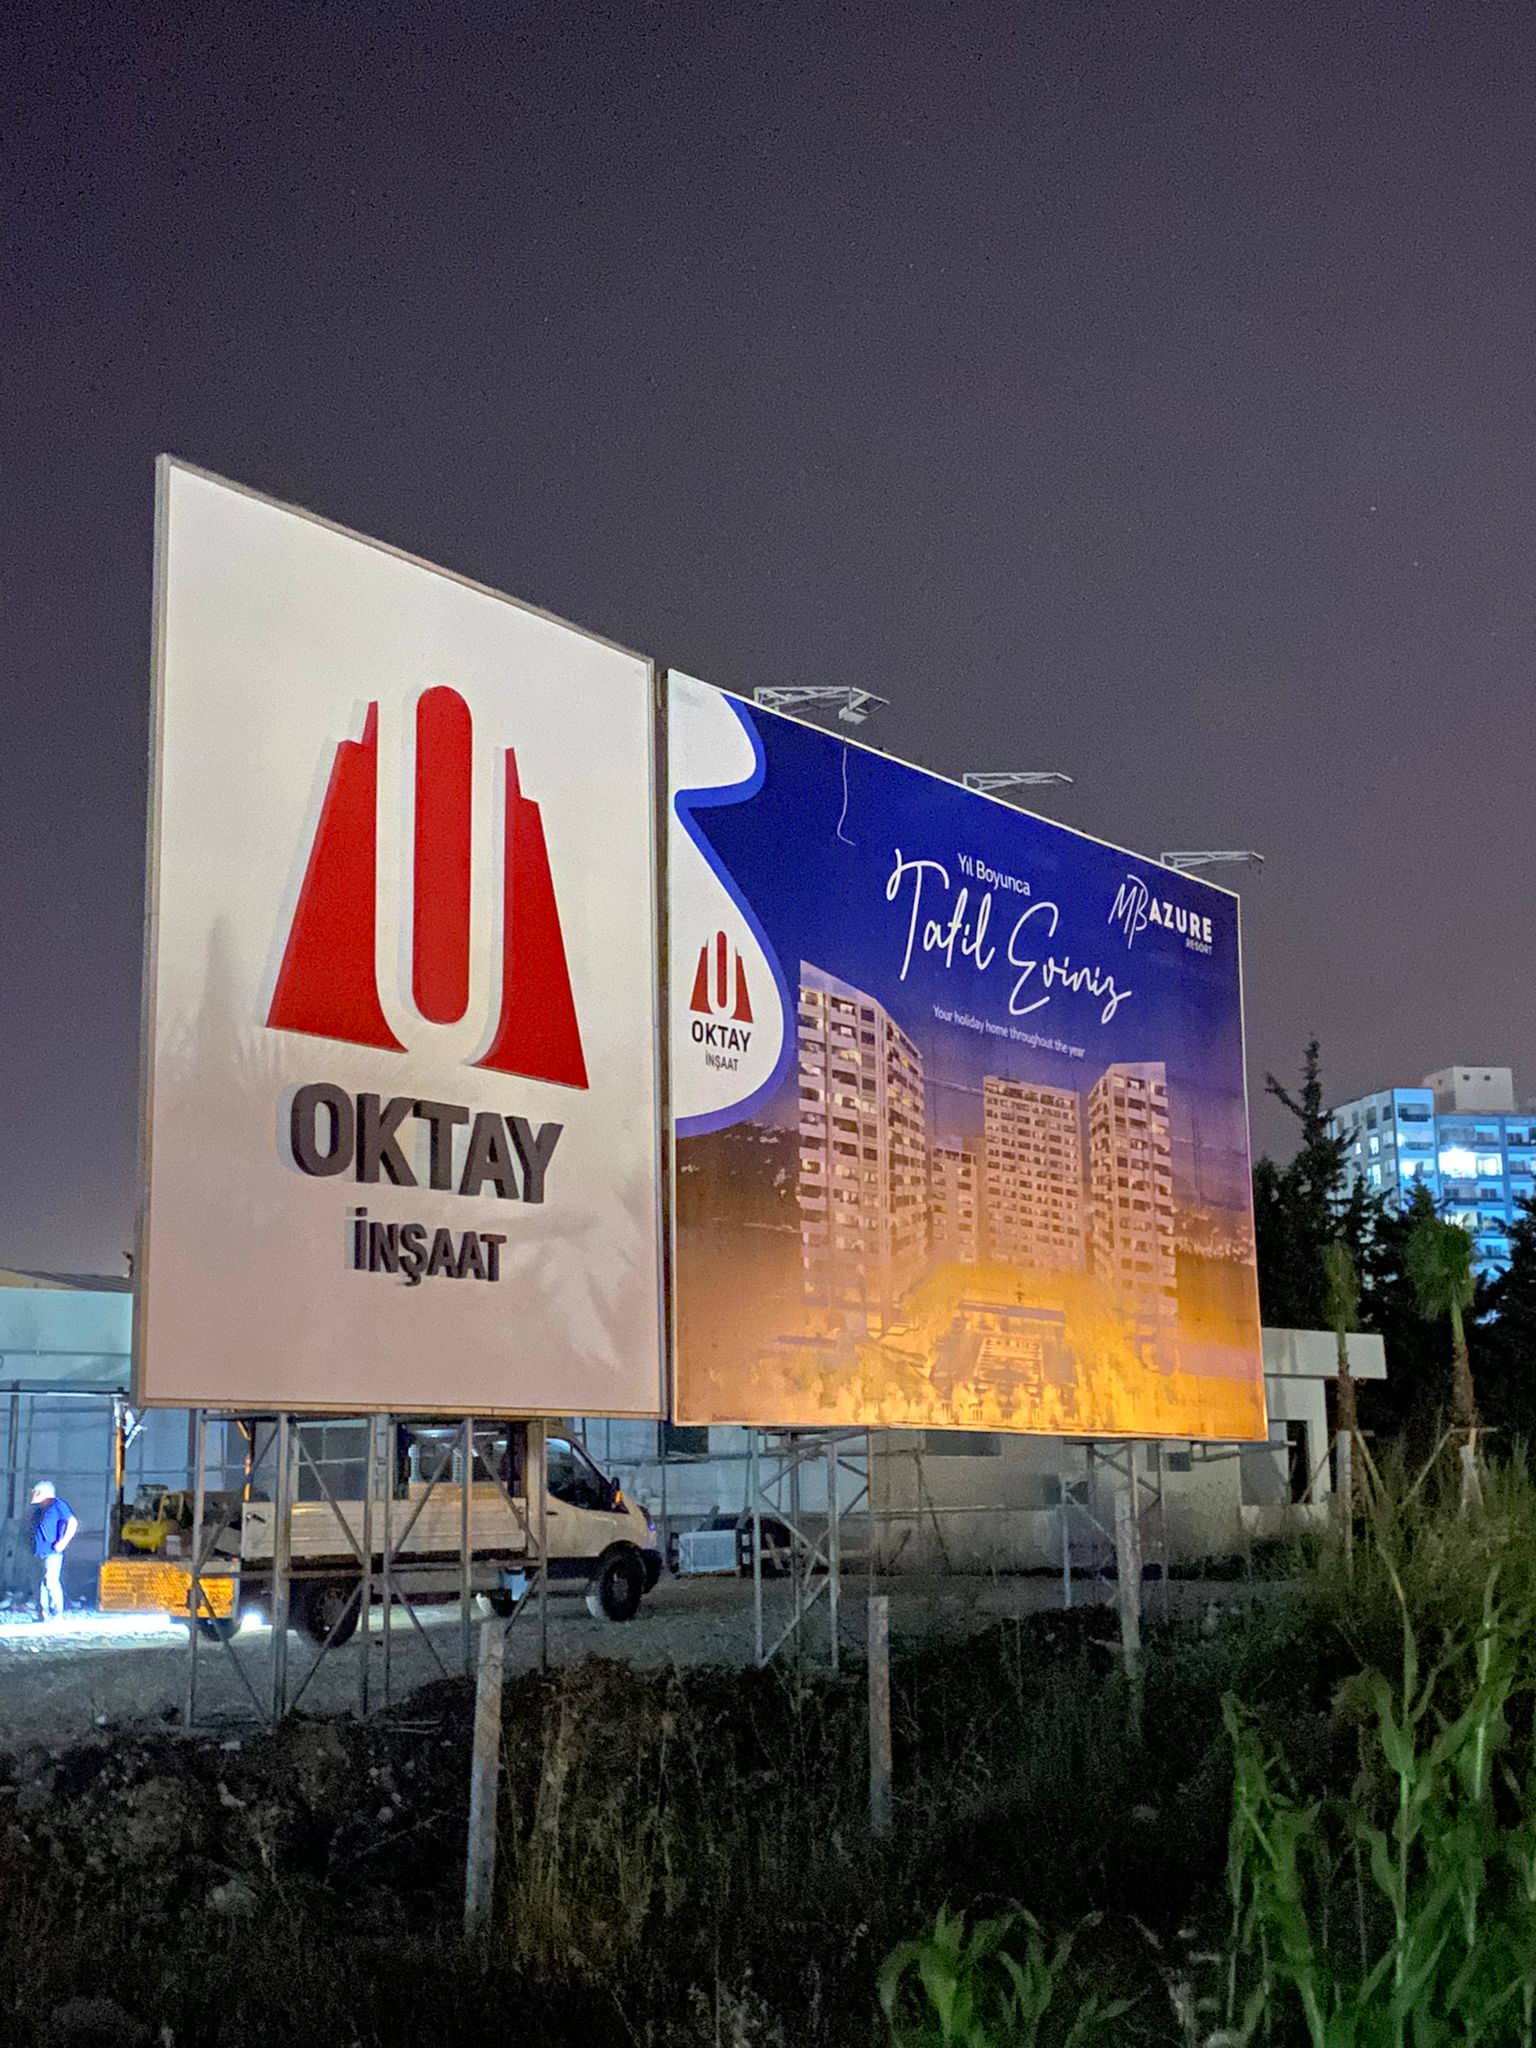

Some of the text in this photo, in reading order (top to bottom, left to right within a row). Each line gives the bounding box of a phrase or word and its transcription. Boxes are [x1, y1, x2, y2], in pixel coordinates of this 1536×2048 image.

[976, 859, 1031, 896] Boyunca
[1148, 897, 1212, 943] AZURE
[1007, 901, 1132, 1024] Eviniz
[691, 1020, 751, 1052] OKTAY
[933, 1004, 1085, 1058] Your holiday home throughout the year
[290, 1082, 563, 1203] OKTAY
[353, 1206, 507, 1286] İNŞAAT
